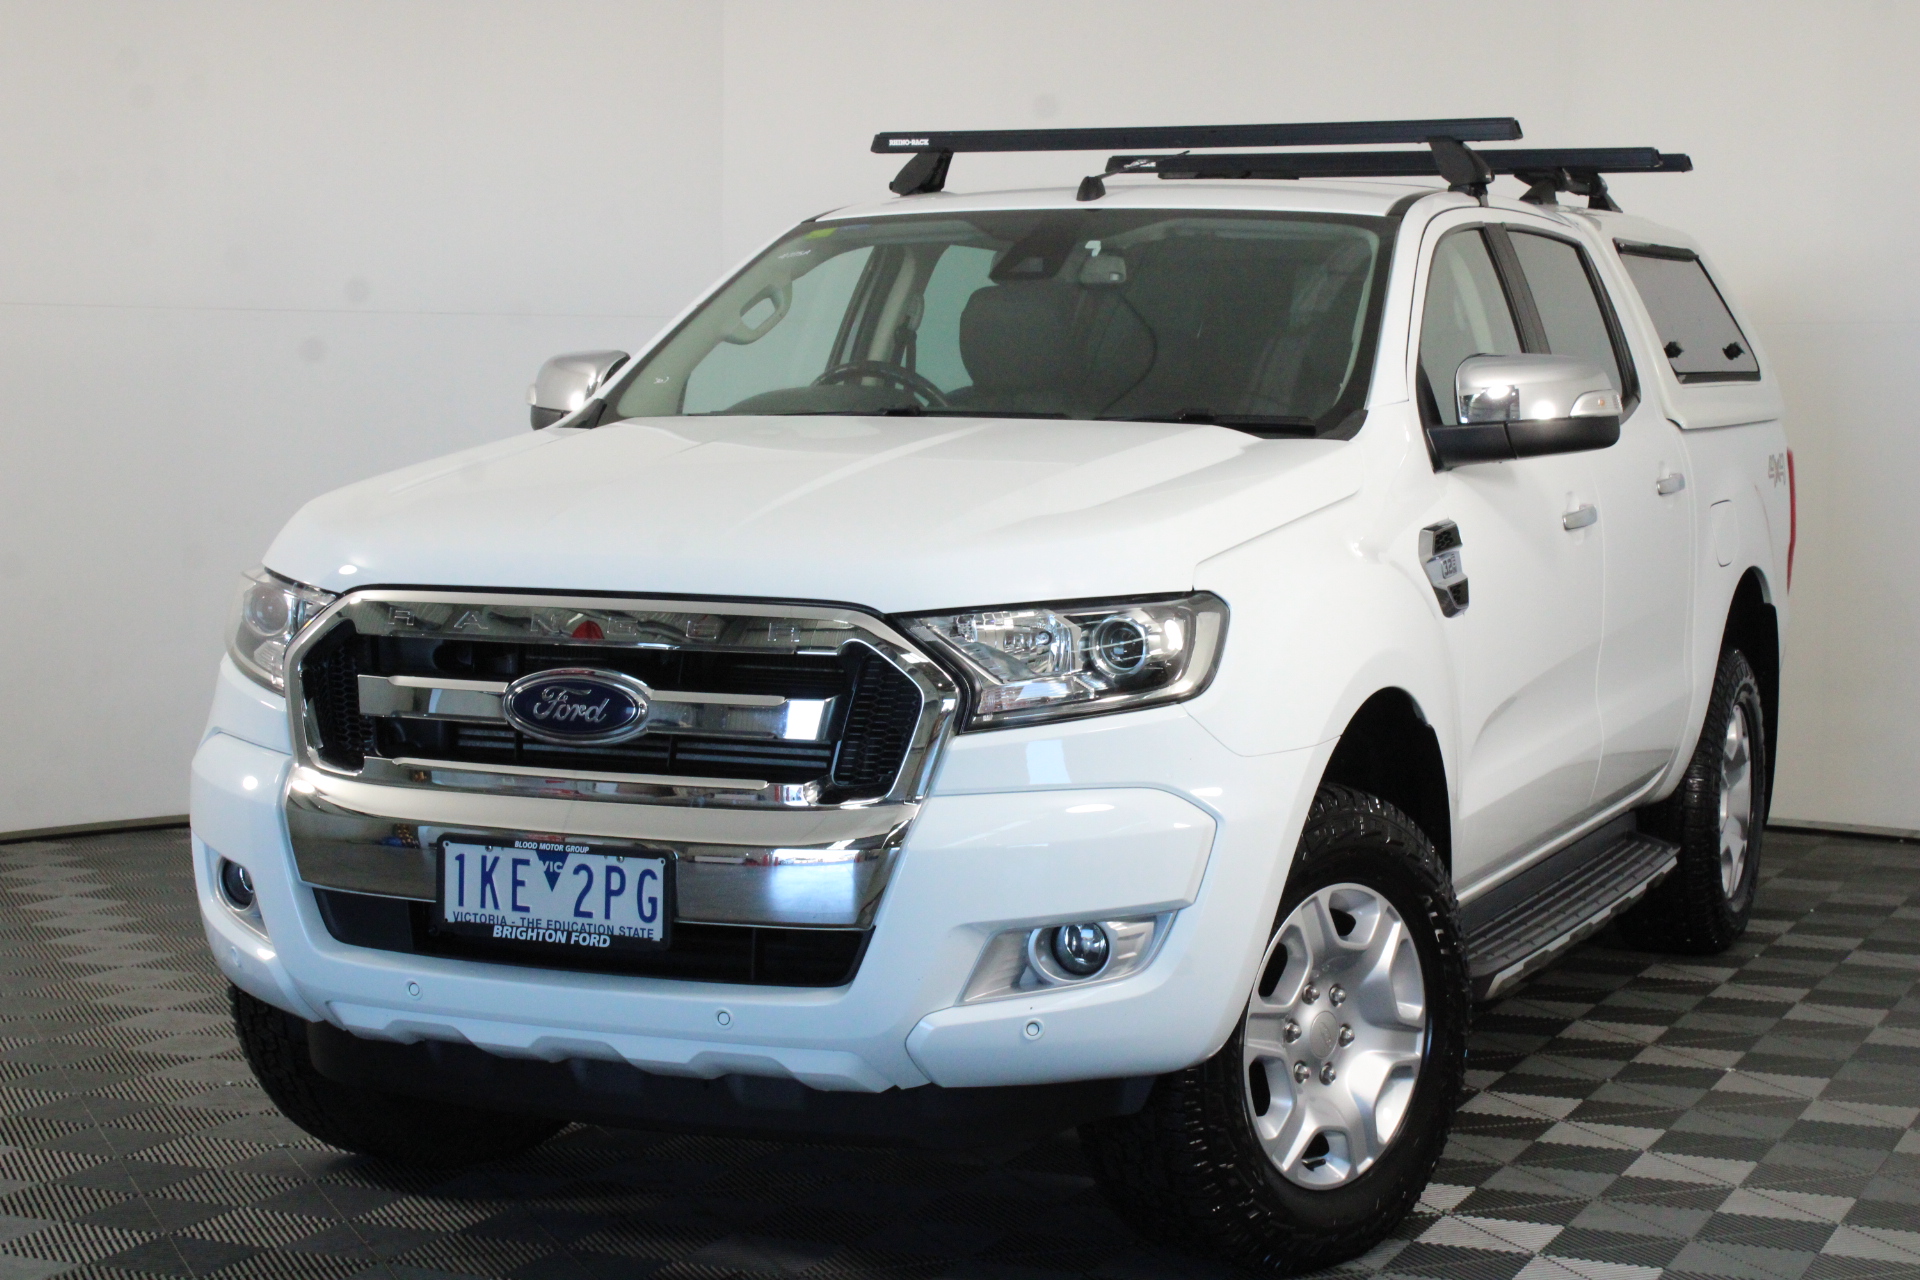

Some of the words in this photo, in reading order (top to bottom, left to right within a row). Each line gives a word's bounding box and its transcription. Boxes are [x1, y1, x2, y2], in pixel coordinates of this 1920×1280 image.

[888, 138, 929, 146] RHINO-RACK
[388, 606, 801, 644] RANGER
[532, 685, 611, 724] Ford
[514, 840, 538, 850] BLOOD
[539, 843, 564, 852] MOTOR
[565, 845, 590, 854] GROUP
[540, 860, 564, 873] VIC
[454, 853, 532, 914] 1KE
[572, 863, 659, 924] 2PG
[453, 911, 508, 925] VICTORIA
[520, 917, 542, 928] THE
[547, 919, 615, 935] EDUCATION
[618, 926, 655, 940] STATE
[492, 925, 568, 944] BRIGHTON
[570, 931, 611, 948] FORD
